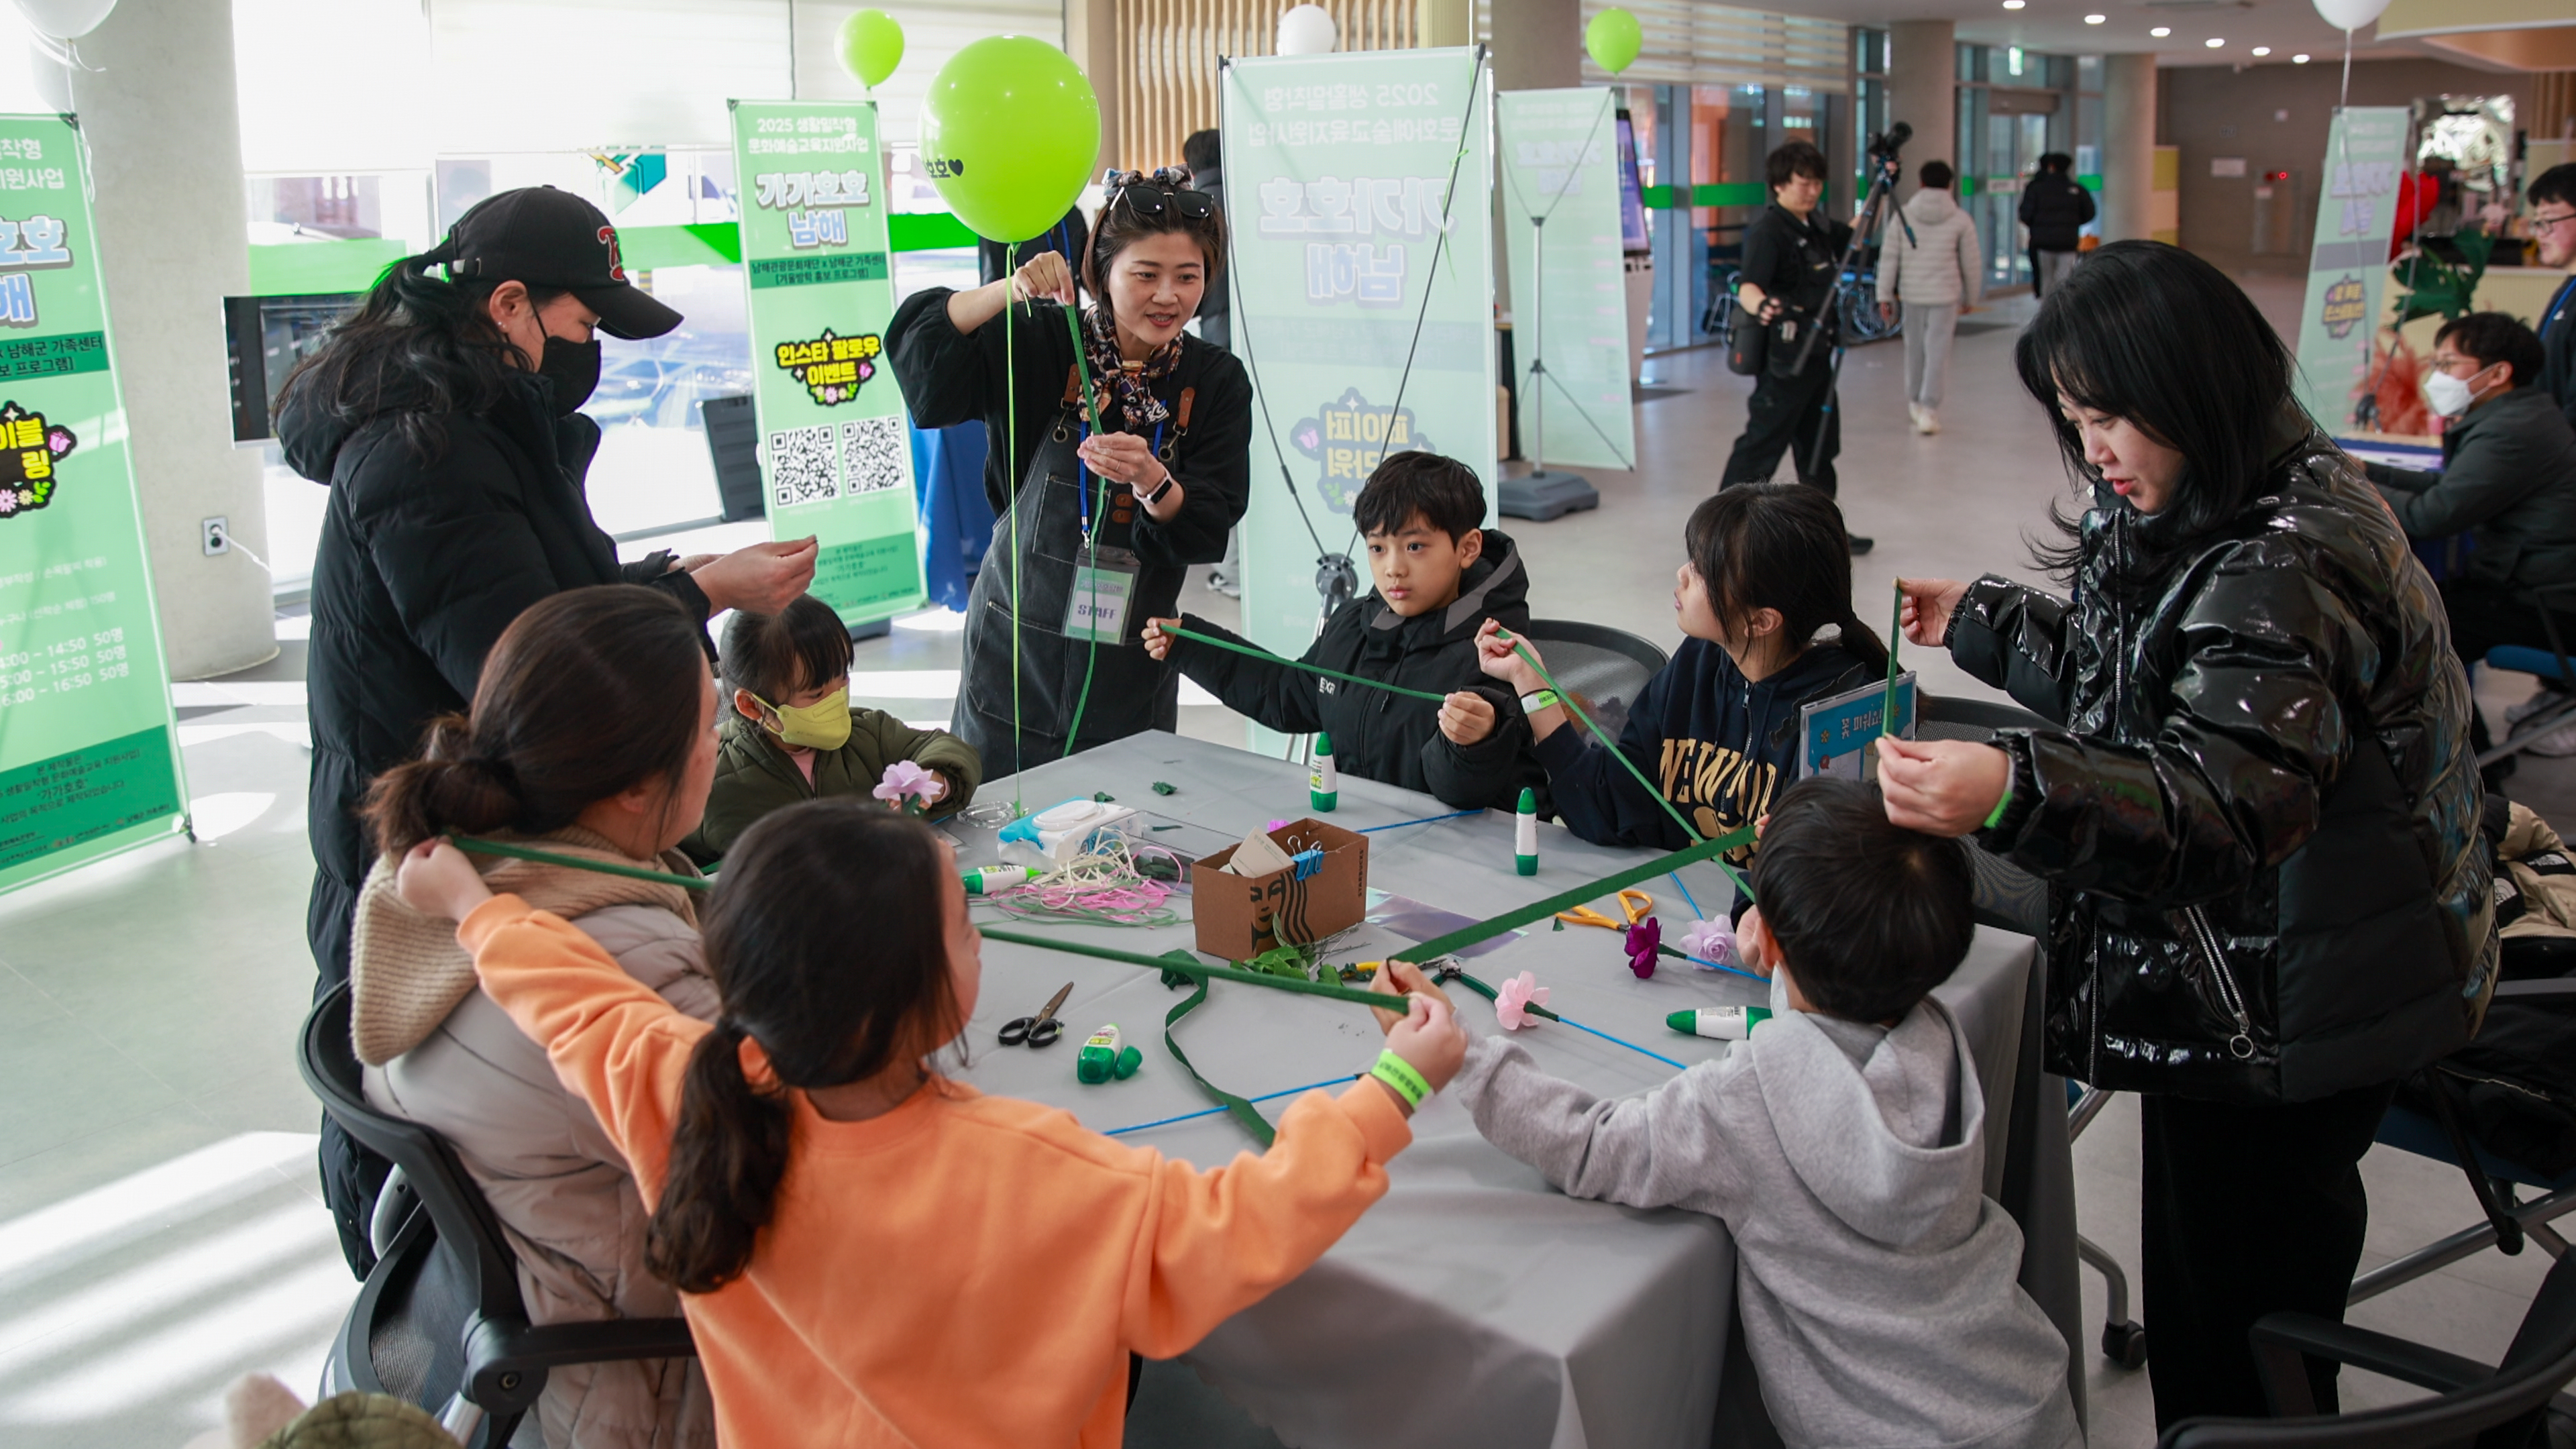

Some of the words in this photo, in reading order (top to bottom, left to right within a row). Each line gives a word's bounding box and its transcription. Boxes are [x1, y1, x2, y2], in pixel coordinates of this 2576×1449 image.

[757, 117, 793, 132] 2025
[756, 170, 869, 207] 가가호호
[788, 209, 847, 247] 남해
[7, 343, 47, 359] 남해군
[52, 336, 103, 354] 가족센터
[777, 343, 828, 366] 인스타
[831, 336, 880, 360] 팔로우
[16, 356, 74, 375] 프로그램]
[807, 362, 857, 386] 이벤트
[47, 637, 87, 657] 14:50
[93, 627, 123, 646] 50명
[50, 655, 89, 675] 15:50
[97, 645, 126, 663] 50명
[53, 673, 93, 693] 16:50
[99, 661, 129, 681] 50명
